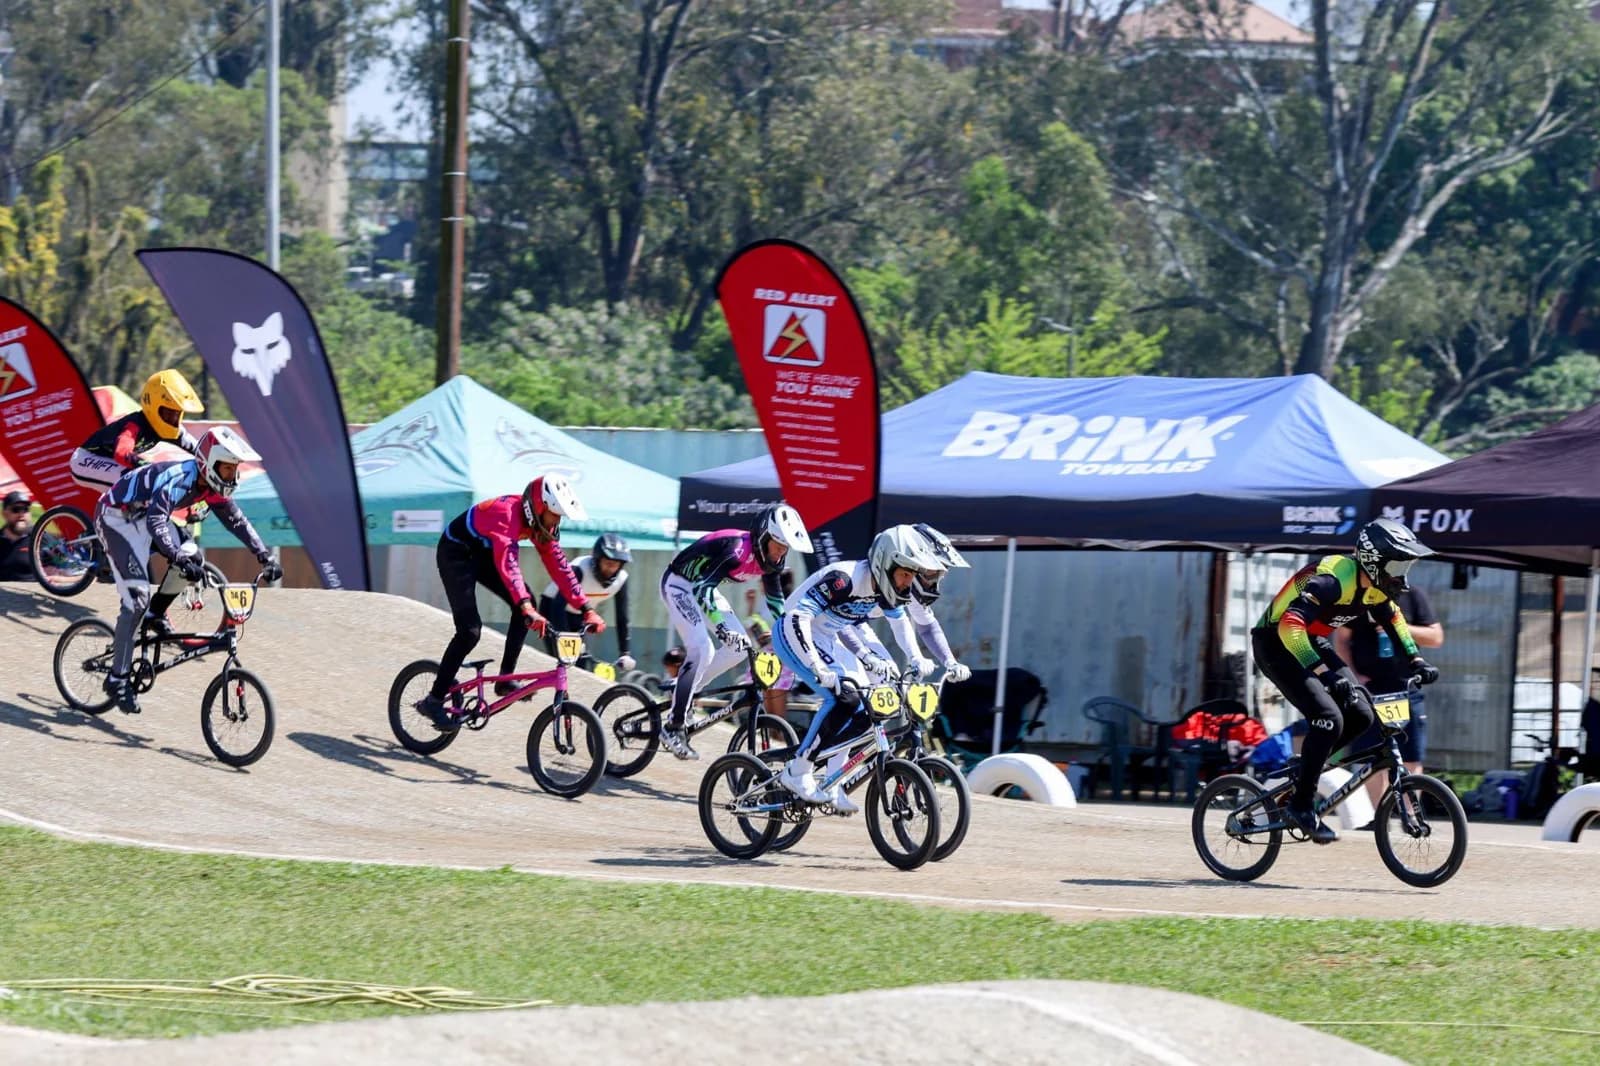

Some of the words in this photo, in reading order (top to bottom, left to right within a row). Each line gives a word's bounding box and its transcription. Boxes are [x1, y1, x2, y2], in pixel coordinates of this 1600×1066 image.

[753, 288, 787, 301] RED
[788, 292, 837, 307] ALERT
[775, 381, 809, 395] YOU
[809, 384, 856, 399] SHINE
[78, 457, 118, 472] SHIFT
[1059, 459, 1211, 476] TOWBARS
[1412, 508, 1474, 533] FOX
[240, 590, 247, 608] 6
[766, 660, 774, 678] 4
[876, 691, 895, 708] 58
[918, 691, 928, 713] 1
[1385, 704, 1402, 720] 51
